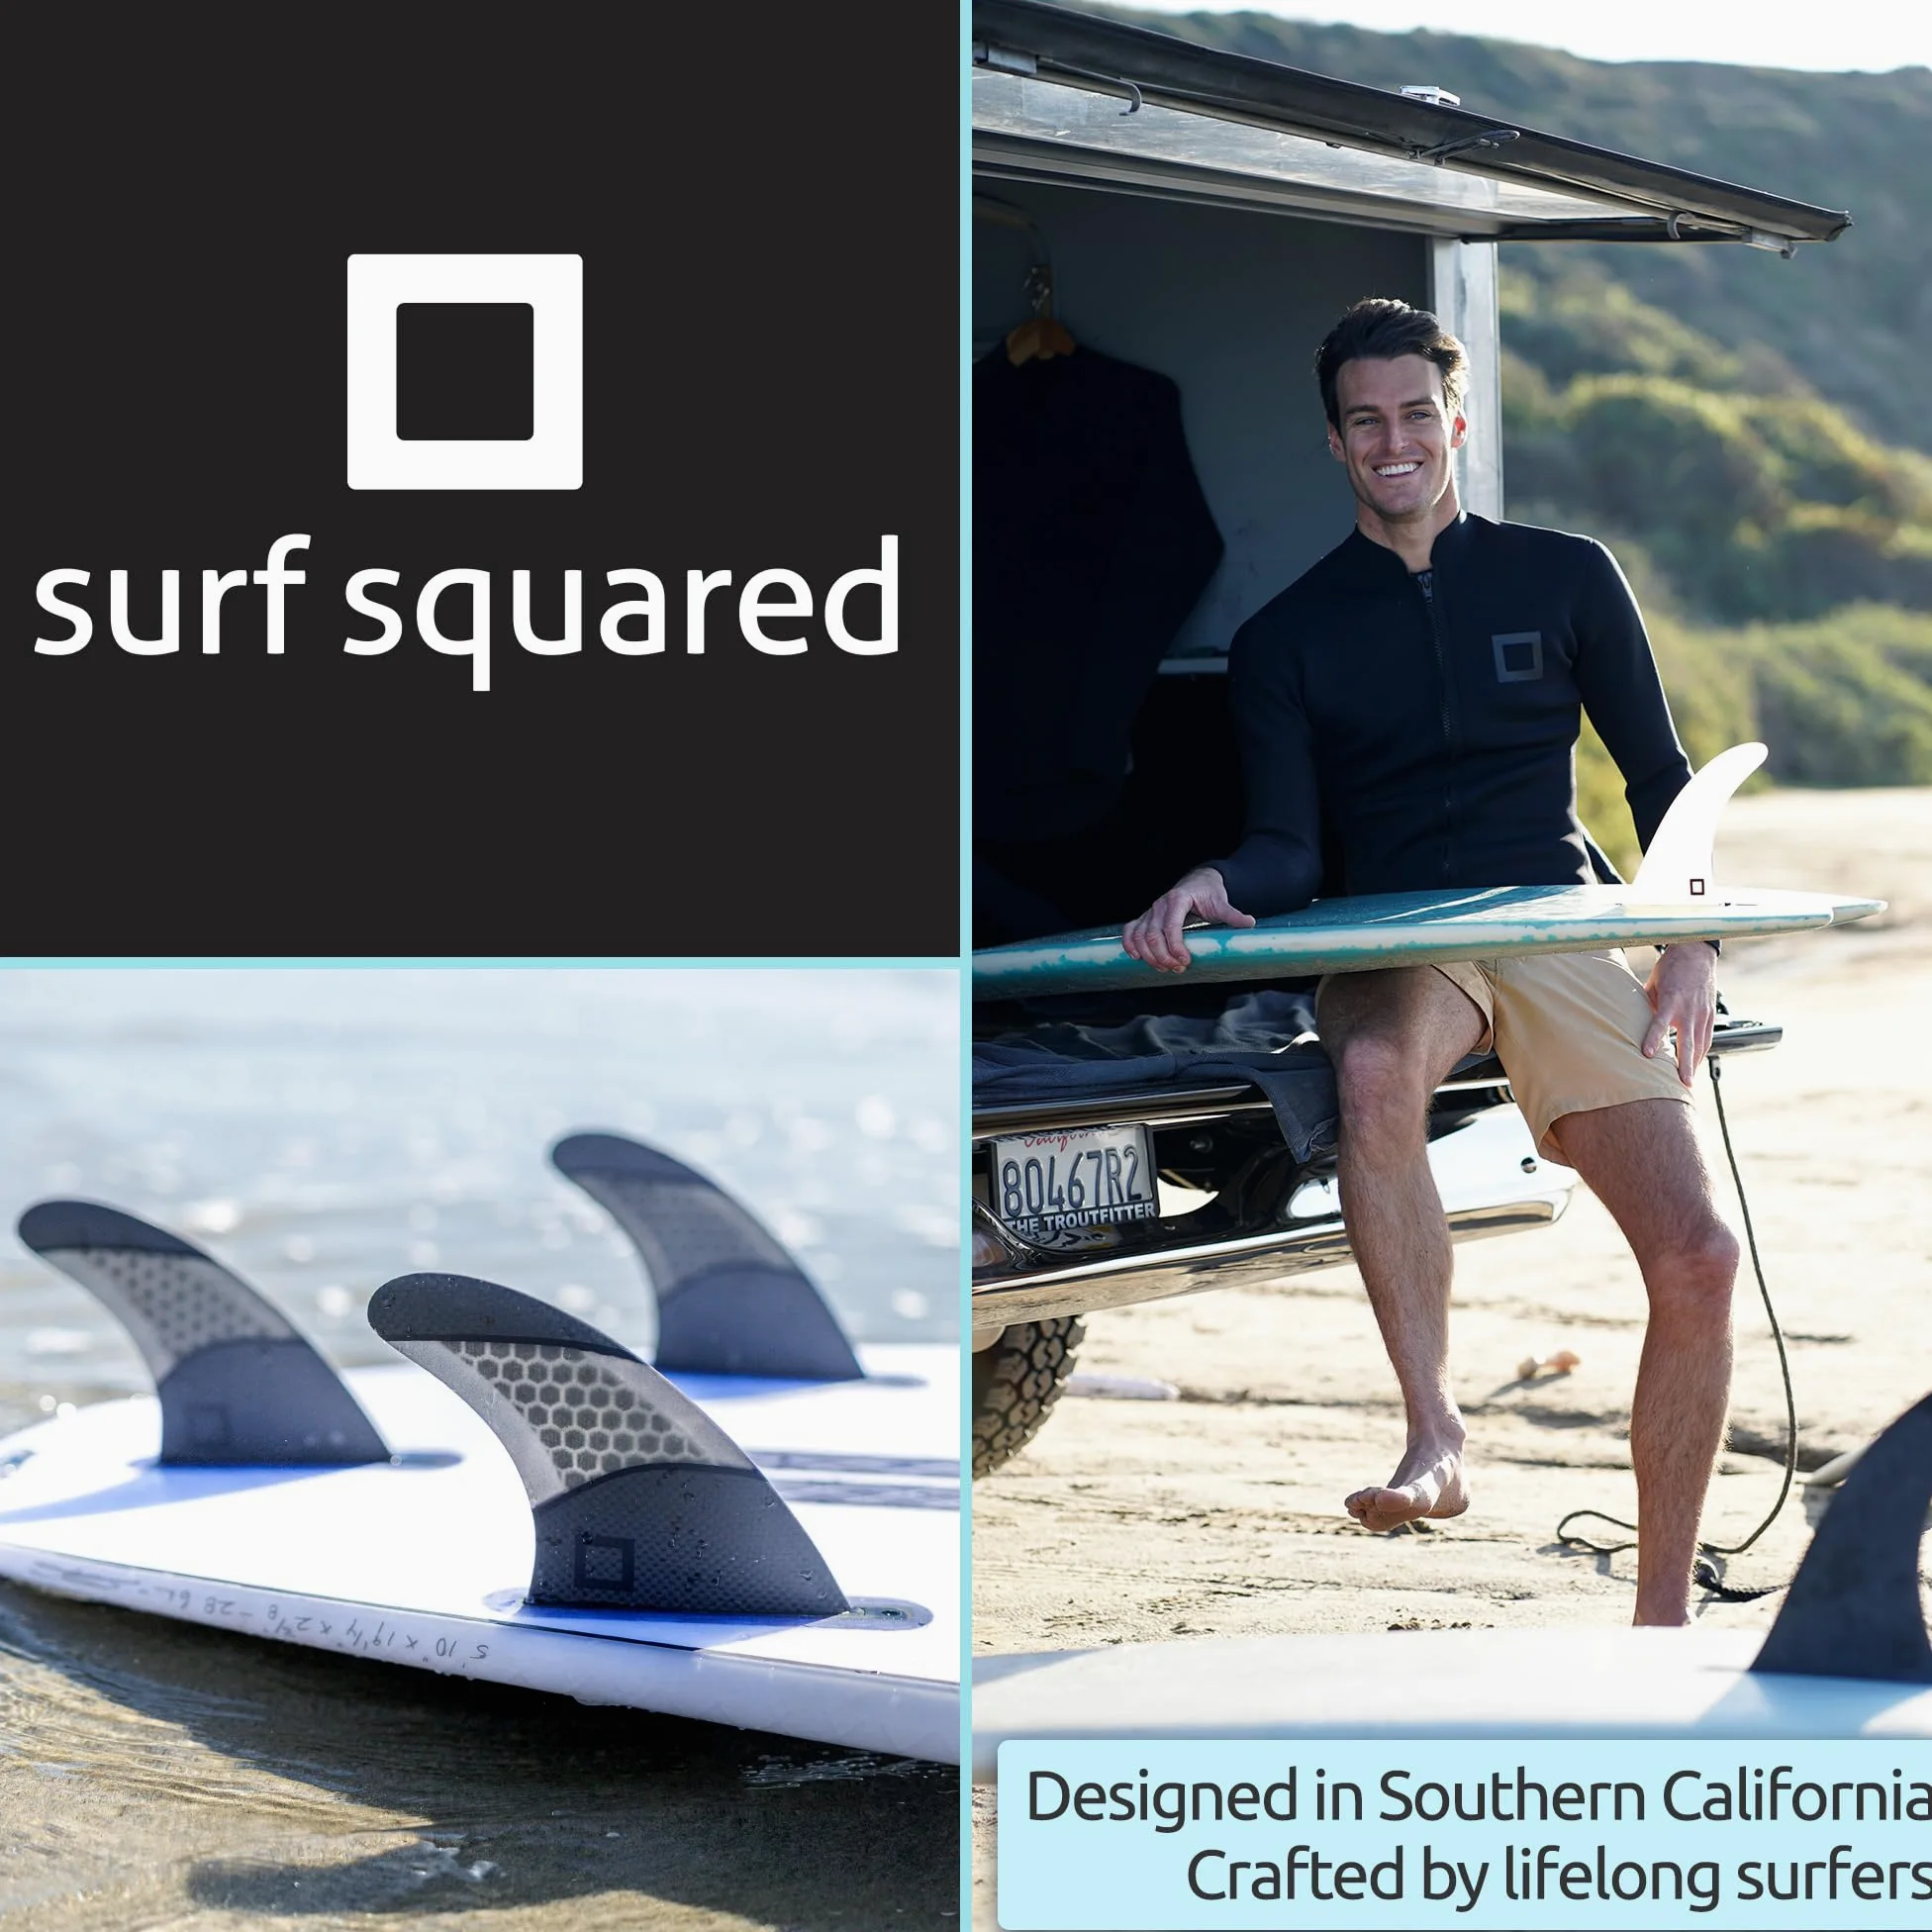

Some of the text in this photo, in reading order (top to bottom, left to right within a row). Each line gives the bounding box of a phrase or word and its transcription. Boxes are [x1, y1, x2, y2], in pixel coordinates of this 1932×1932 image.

[1002, 1144, 1142, 1217] 80467R2
[1006, 1202, 1156, 1234] THE TROUTFITTER
